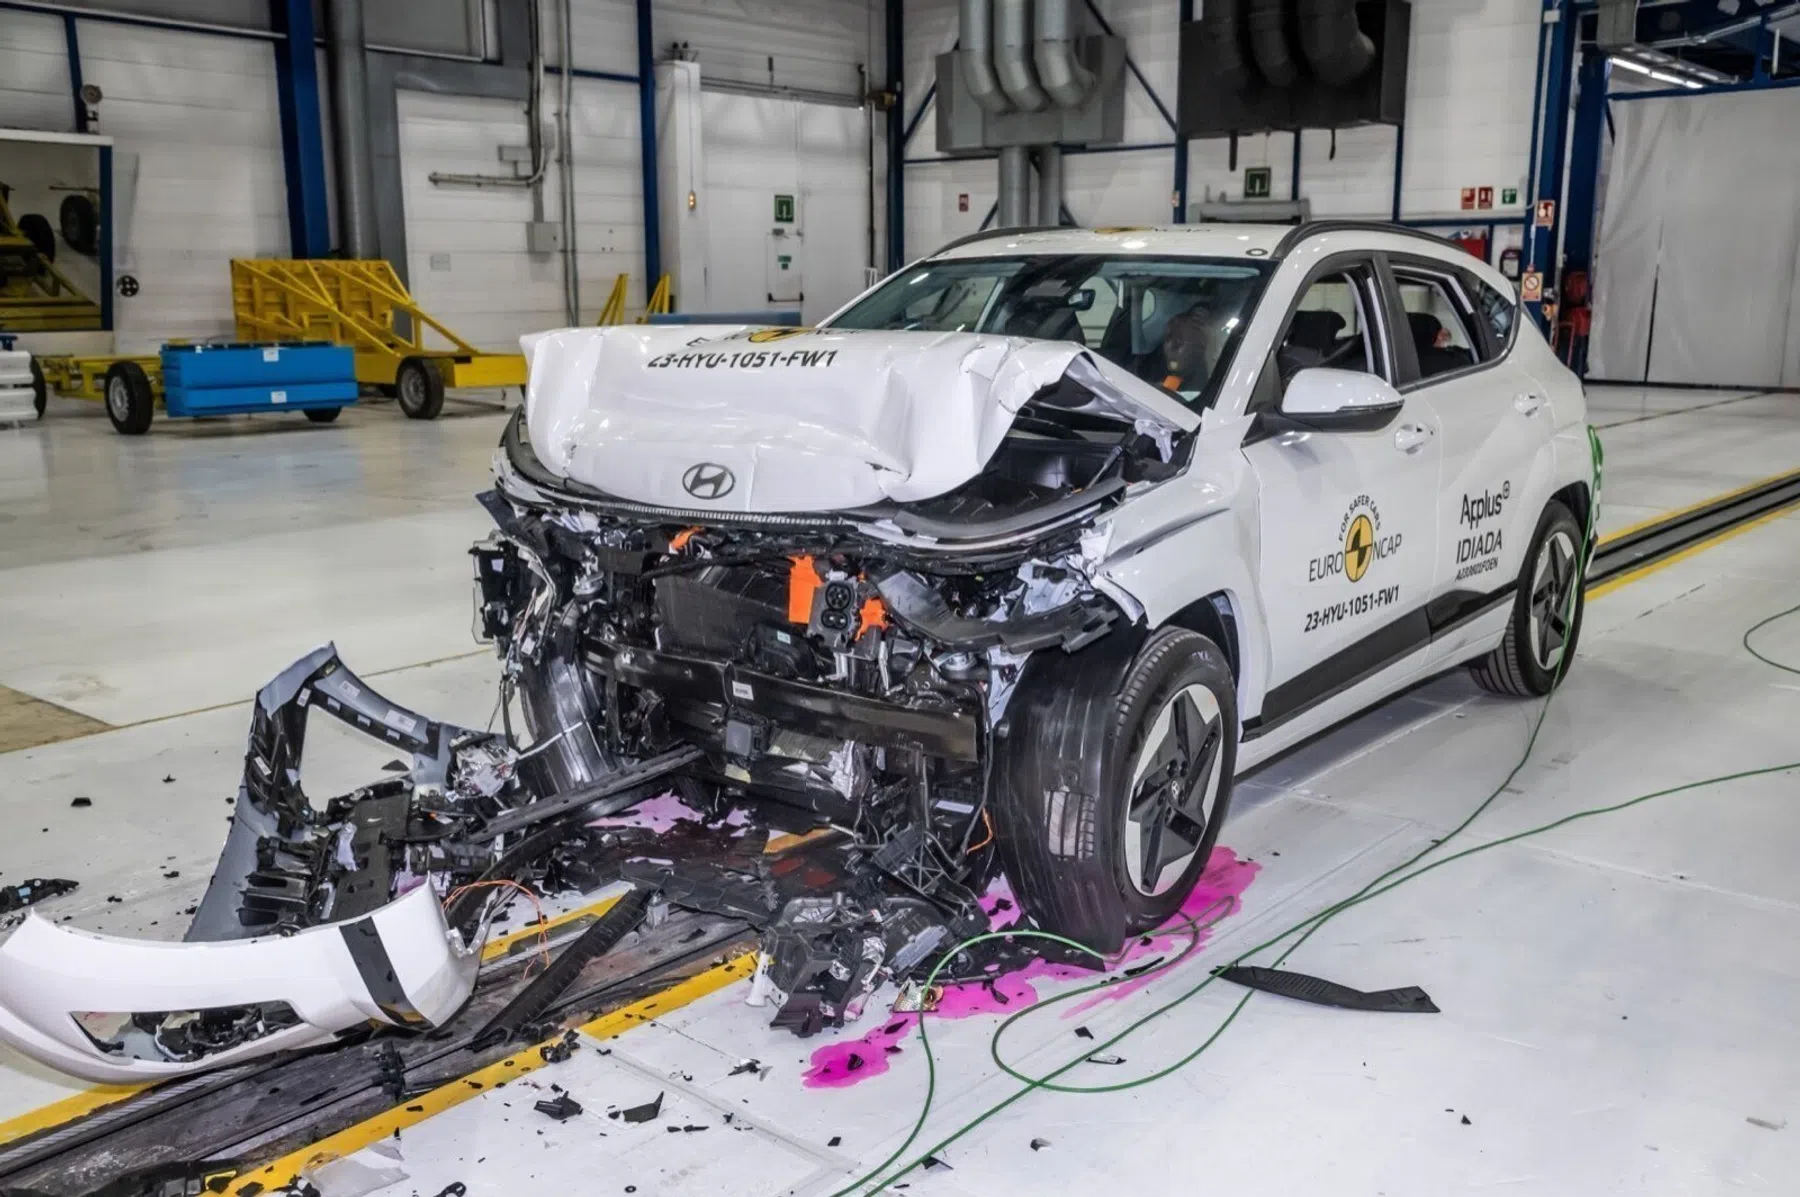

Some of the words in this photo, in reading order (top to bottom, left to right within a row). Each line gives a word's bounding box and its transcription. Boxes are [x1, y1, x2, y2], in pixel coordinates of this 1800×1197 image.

[1338, 512, 1350, 542] FOR
[1349, 494, 1371, 514] SAFER
[1370, 500, 1381, 531] CARS
[1308, 551, 1344, 582] EURO
[1372, 533, 1402, 561] NCAP
[1456, 528, 1503, 564] IDIADA
[1304, 584, 1400, 633] 23-HYU-1051-FW1
